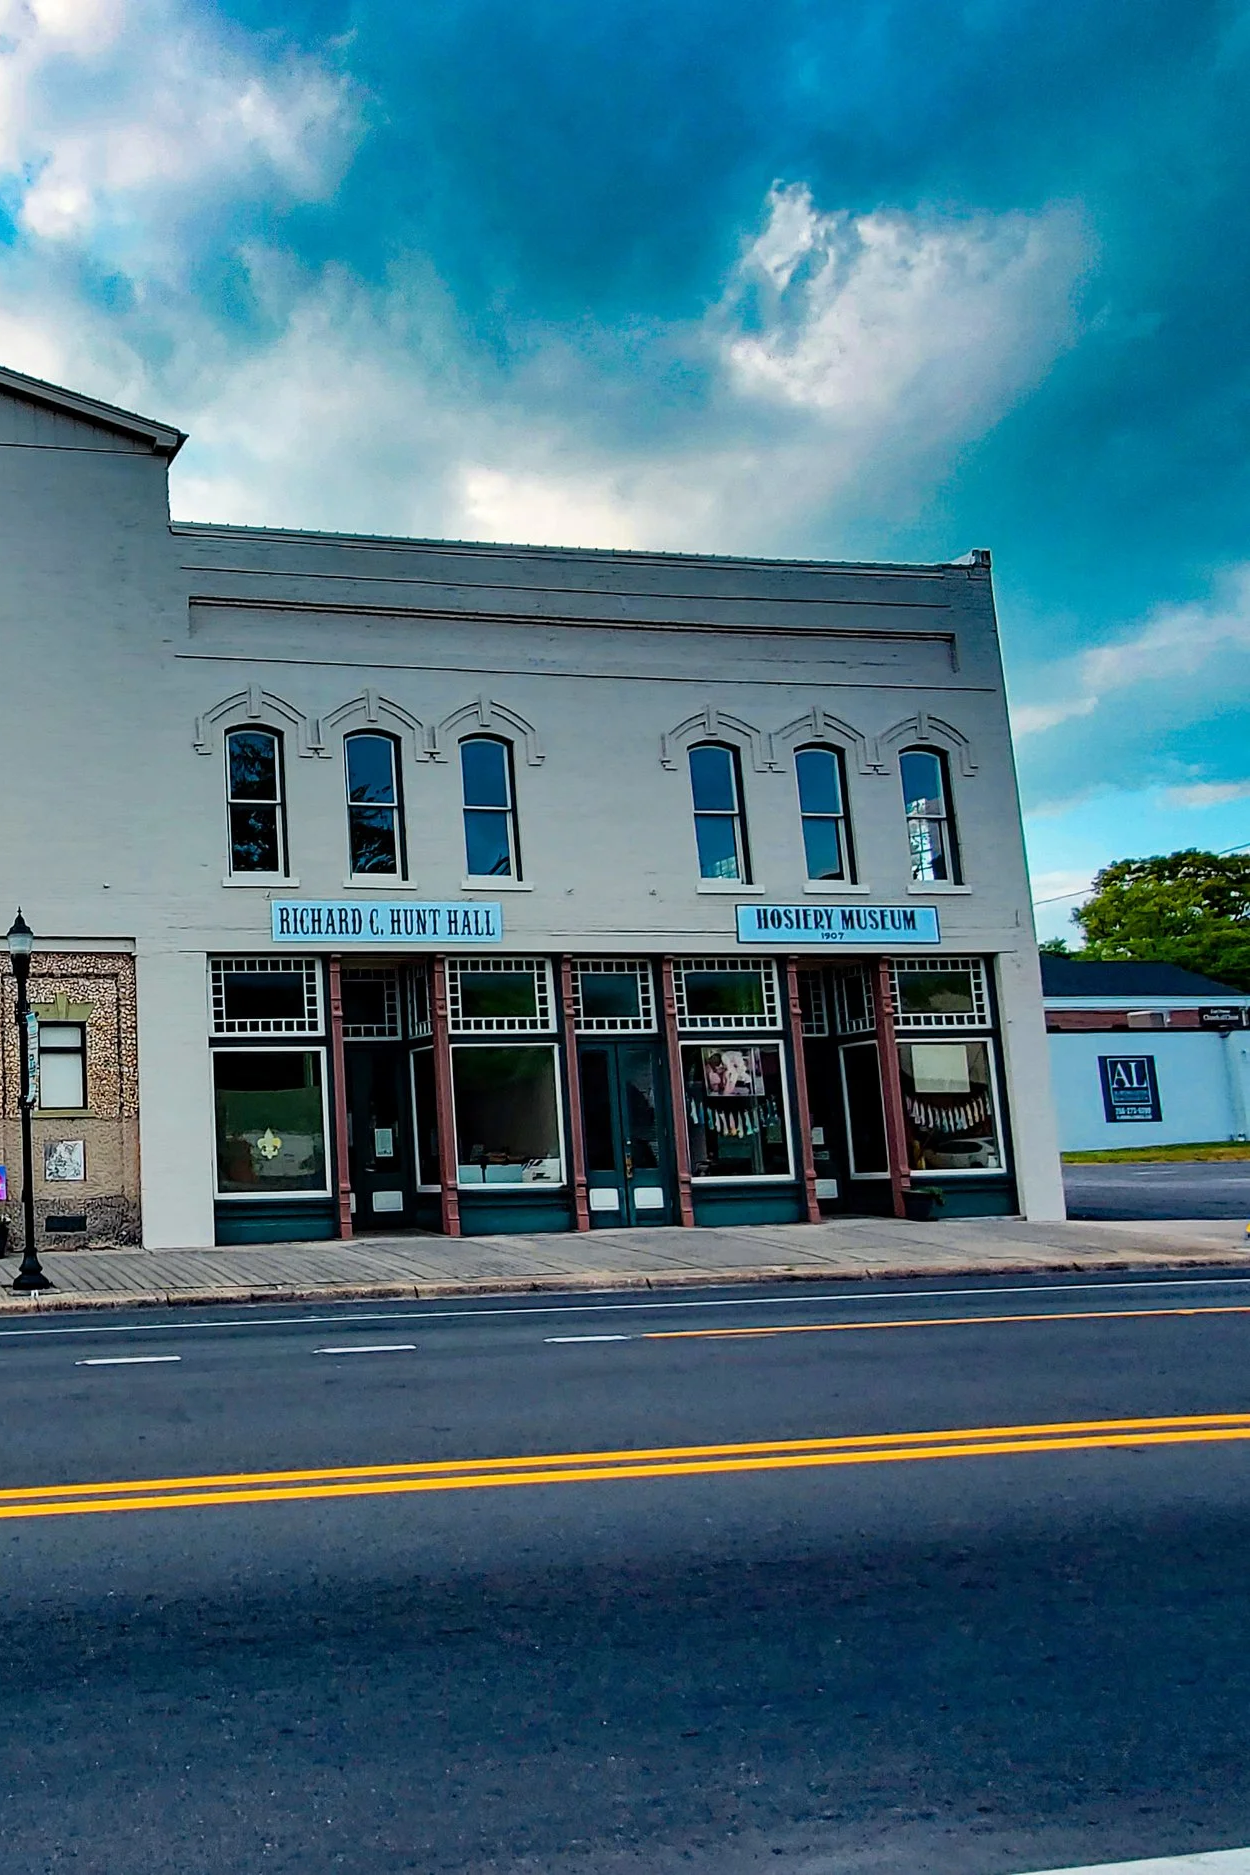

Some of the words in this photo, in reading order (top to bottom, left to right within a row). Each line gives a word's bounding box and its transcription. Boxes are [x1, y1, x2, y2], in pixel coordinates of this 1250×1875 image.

[278, 907, 363, 935] RICHARD
[369, 908, 384, 936] C.
[390, 908, 441, 936] HUNT
[447, 909, 496, 937] HALL
[755, 908, 835, 930] HOSIERY
[840, 909, 918, 931] MUSEUM
[821, 932, 845, 940] 1907
[1112, 1062, 1147, 1088] AL
